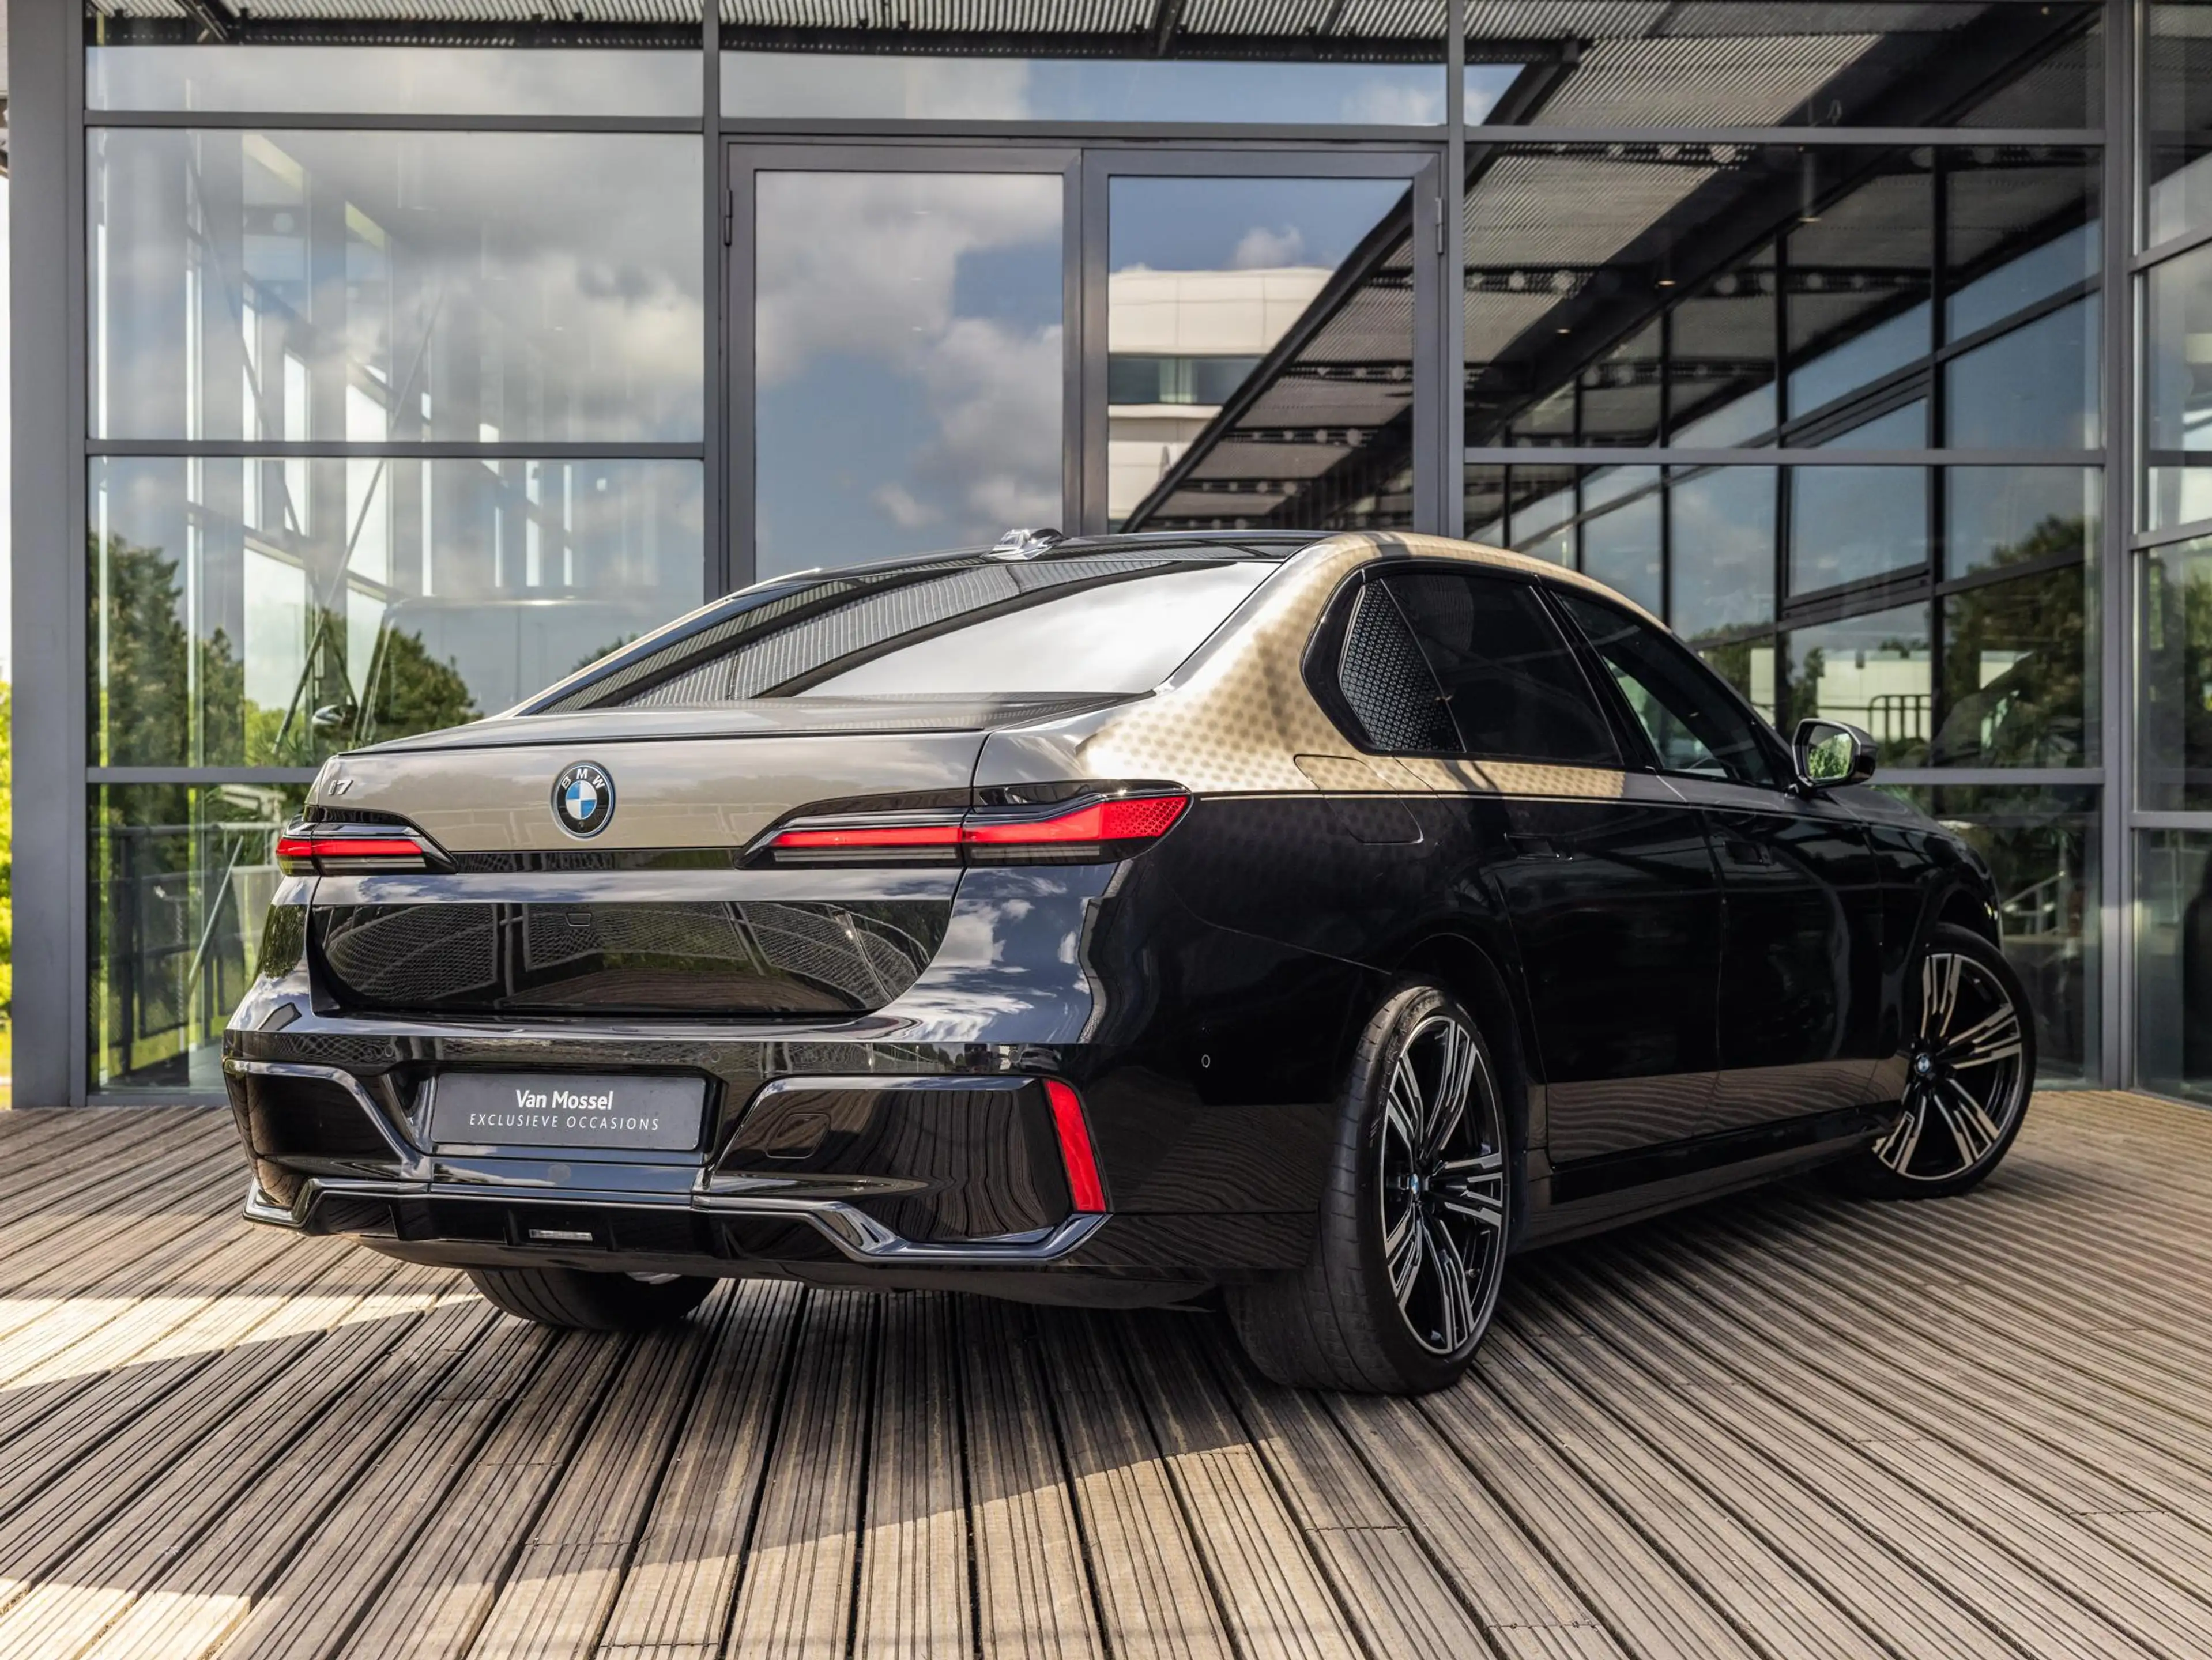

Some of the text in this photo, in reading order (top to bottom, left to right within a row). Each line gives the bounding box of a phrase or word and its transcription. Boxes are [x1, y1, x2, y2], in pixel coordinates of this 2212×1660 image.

[561, 768, 606, 790] BMW
[516, 1090, 613, 1110] Van Mossel
[469, 1114, 660, 1131] EXCLUSIEVE OCCASIONS
